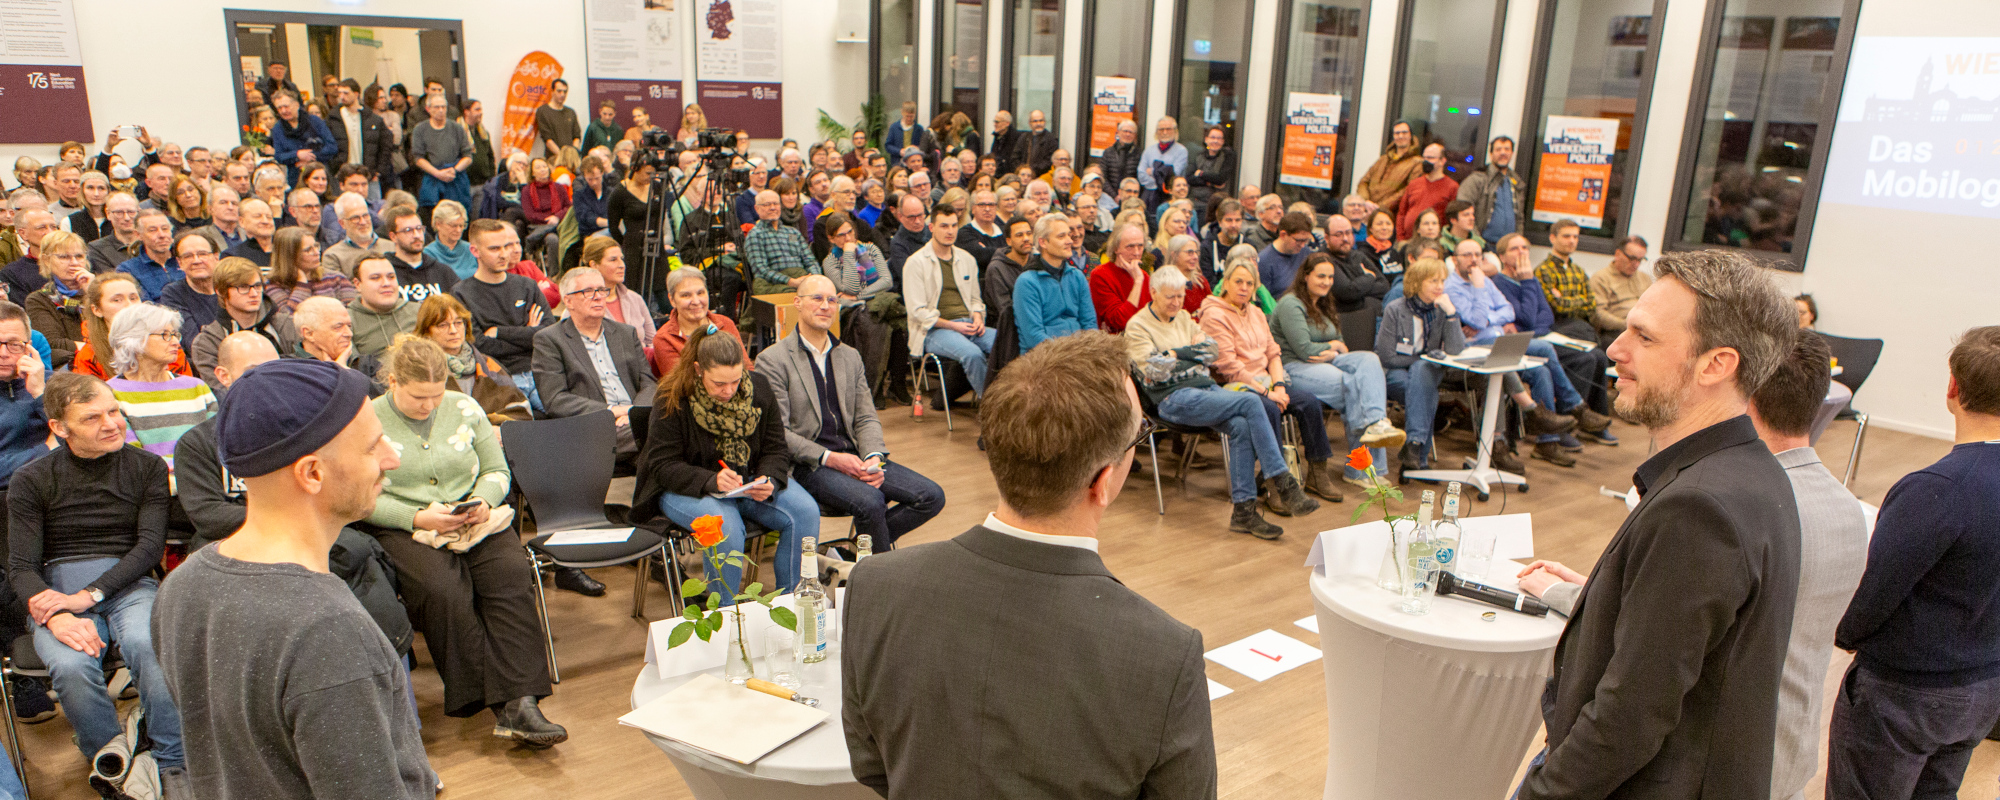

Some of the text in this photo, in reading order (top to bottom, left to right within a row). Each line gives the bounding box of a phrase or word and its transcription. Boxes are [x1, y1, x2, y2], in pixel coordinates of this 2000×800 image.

[26, 71, 49, 89] 175
[1290, 116, 1328, 126] VERKEHRS
[1305, 125, 1335, 134] POLITIK
[1548, 143, 1600, 154] VERKEHRS
[1868, 134, 1933, 163] Das
[1568, 153, 1608, 165] POLITIK
[1861, 168, 2000, 208] Mobilog
